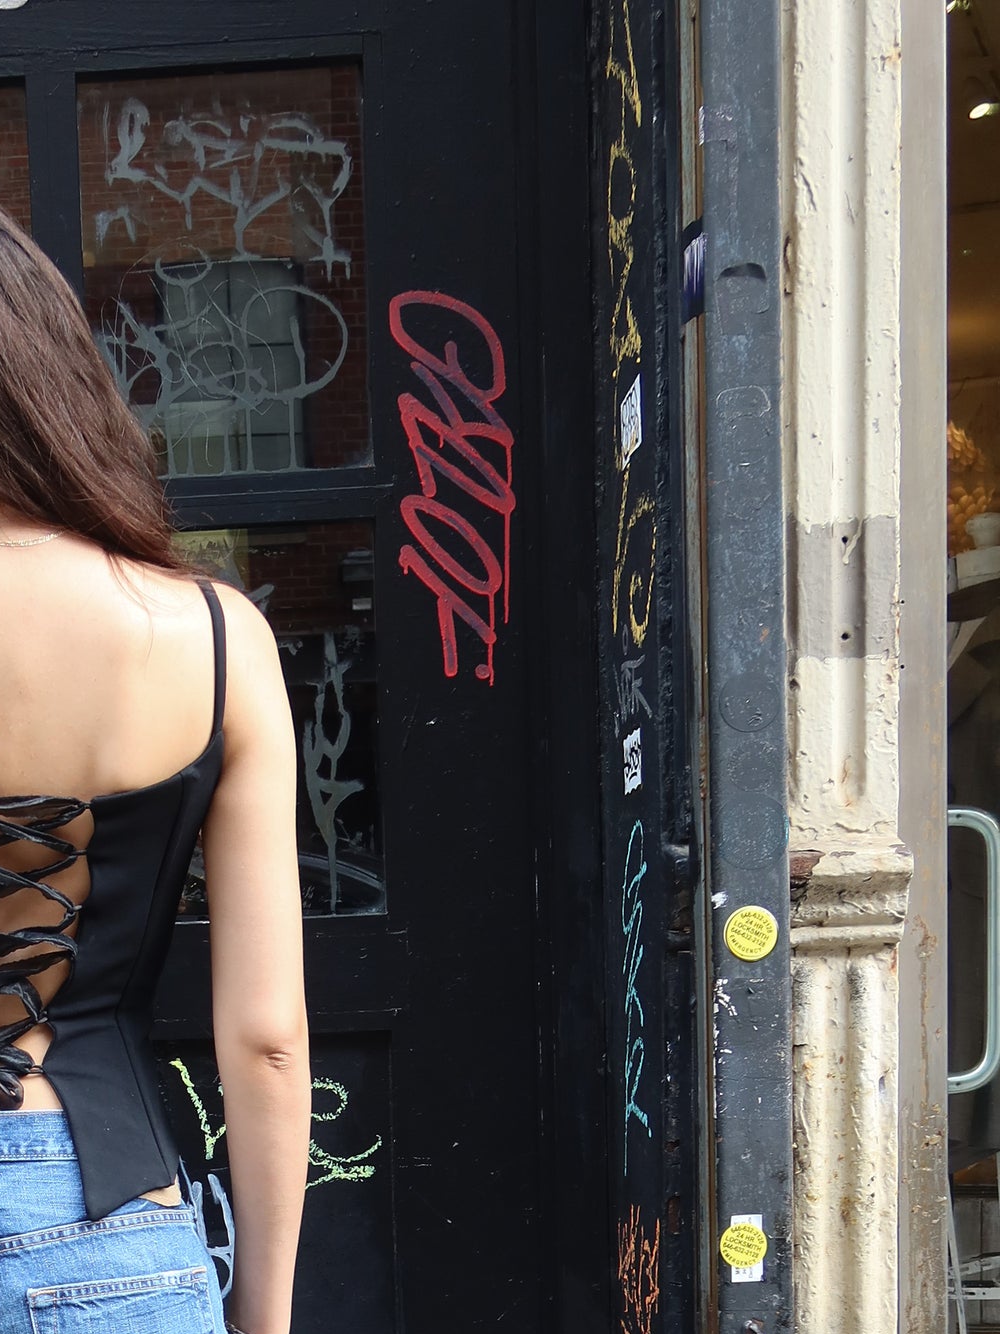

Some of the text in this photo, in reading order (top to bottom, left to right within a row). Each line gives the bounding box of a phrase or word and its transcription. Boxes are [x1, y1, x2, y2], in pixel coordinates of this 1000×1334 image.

[733, 920, 769, 940] LOCKSMITH
[753, 922, 764, 930] HR
[730, 935, 762, 953] EMERGENCY
[725, 1235, 762, 1252] LOCKSMITH
[722, 1249, 756, 1266] EMERGENCY
